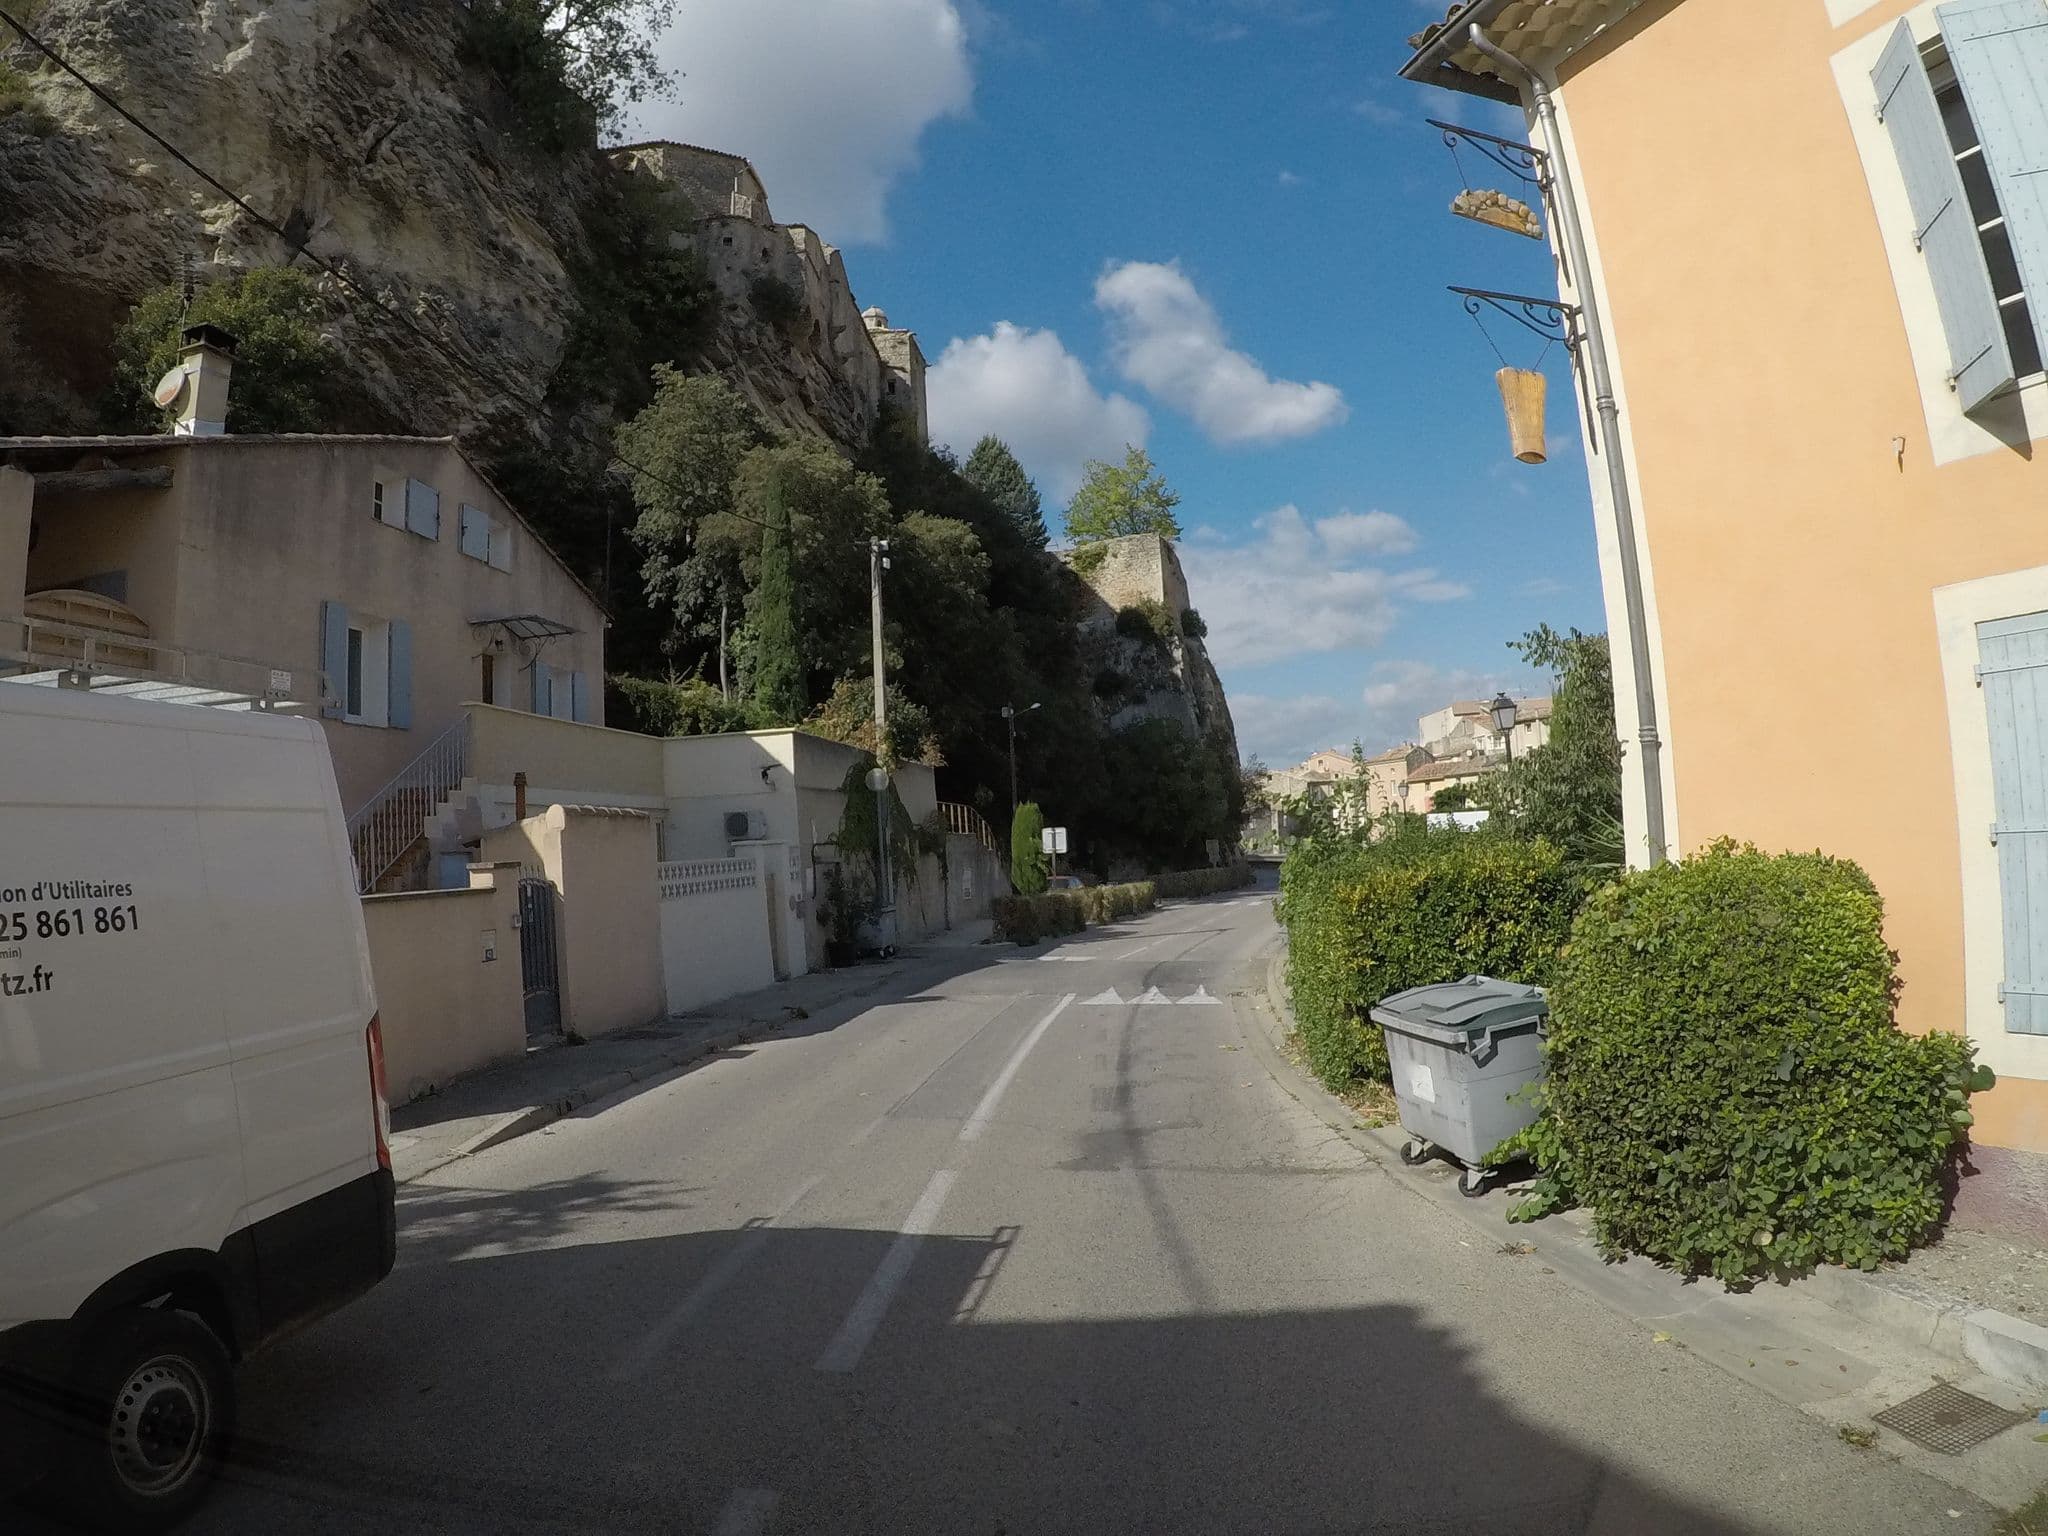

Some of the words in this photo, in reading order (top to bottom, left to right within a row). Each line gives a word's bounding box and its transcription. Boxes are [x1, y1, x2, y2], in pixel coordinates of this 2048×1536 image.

[31, 879, 133, 902] d’Utilitaires
[0, 911, 28, 941] 25
[36, 908, 84, 939] 861
[94, 904, 138, 934] 861
[0, 964, 54, 997] tz.fr
